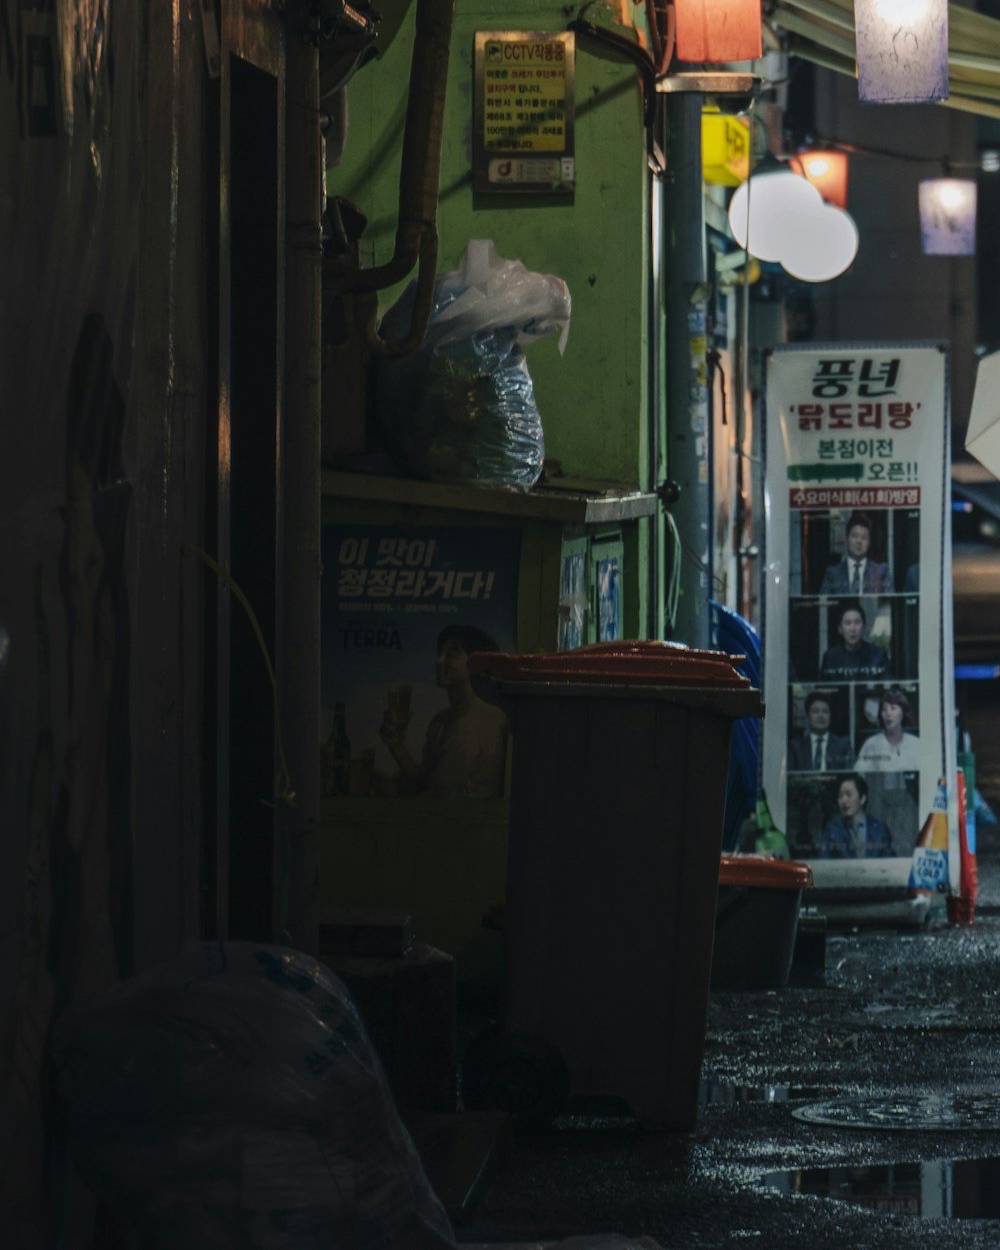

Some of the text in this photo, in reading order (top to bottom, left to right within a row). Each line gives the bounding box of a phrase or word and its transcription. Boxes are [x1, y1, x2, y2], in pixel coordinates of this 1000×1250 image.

[812, 358, 901, 398] 풍년
[867, 462, 918, 481] 오픈!!
[338, 538, 437, 568] 이 맛이
[339, 627, 402, 651] TERRA
